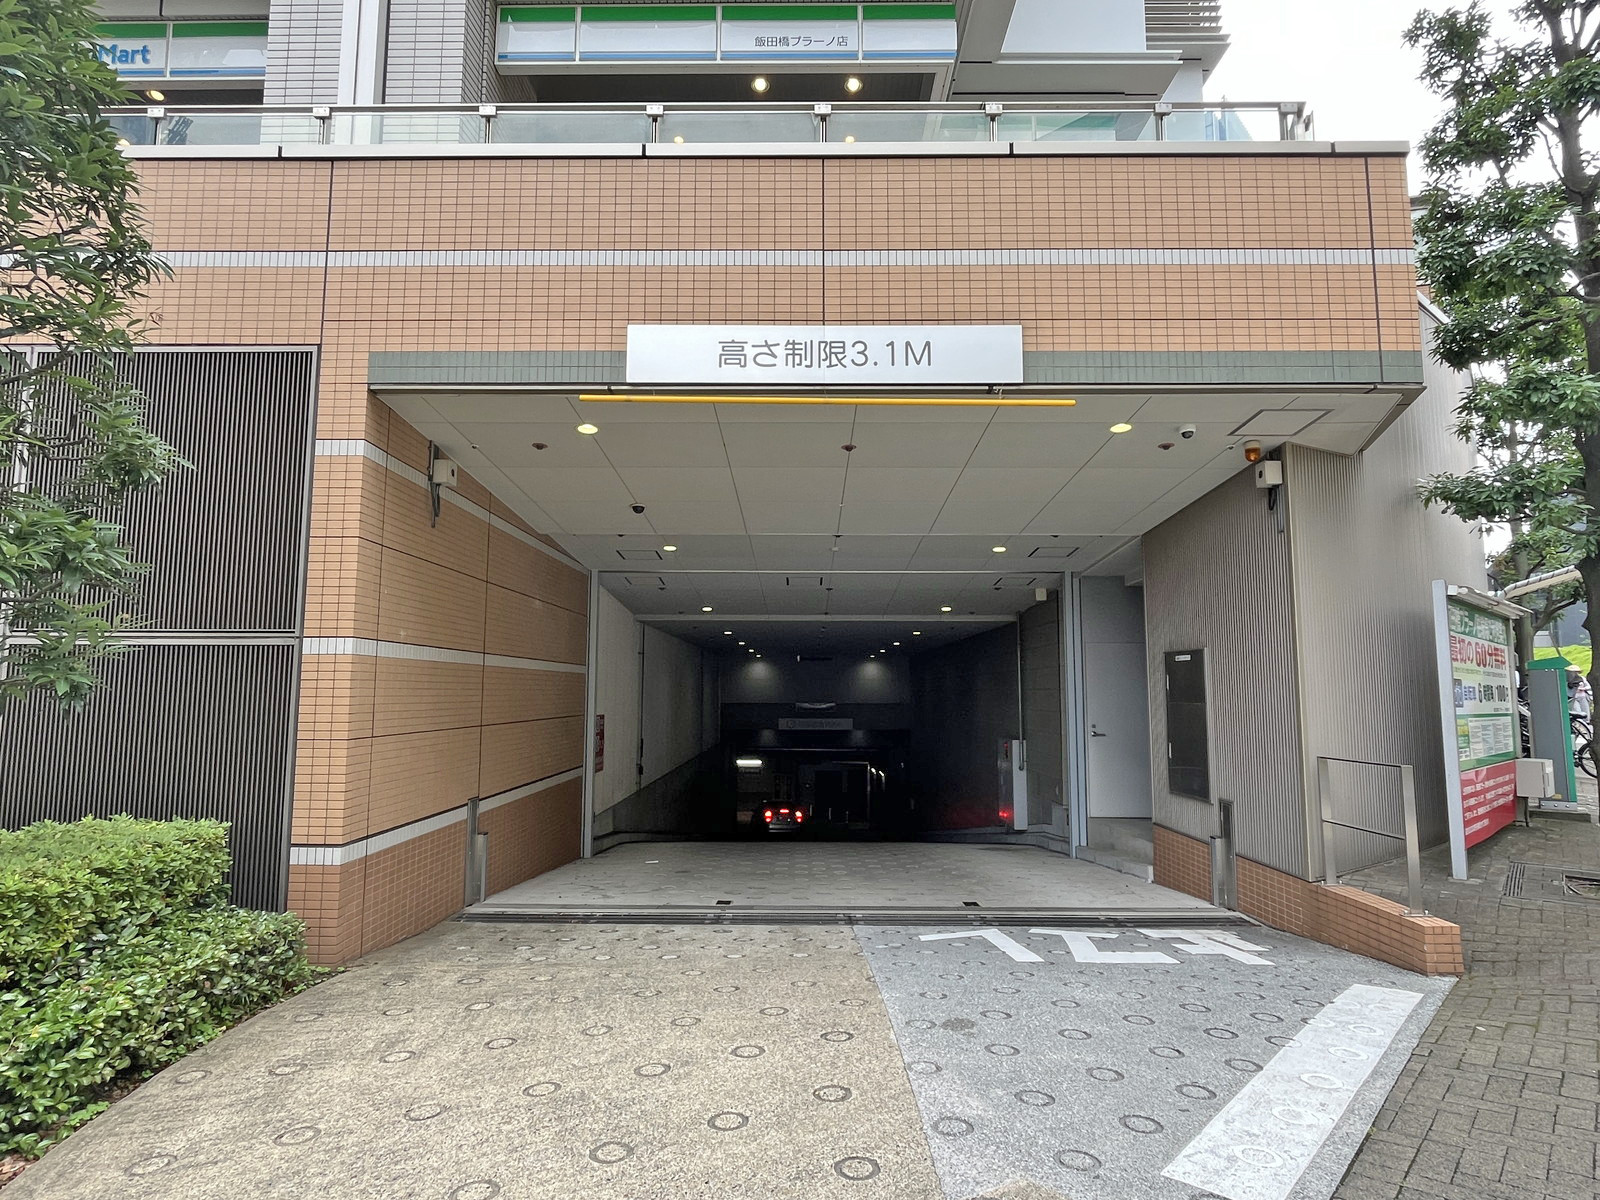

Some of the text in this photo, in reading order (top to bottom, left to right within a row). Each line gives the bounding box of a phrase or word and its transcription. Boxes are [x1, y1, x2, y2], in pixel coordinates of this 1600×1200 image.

[754, 36, 849, 47] 飯田橋プラーノ店
[718, 339, 933, 369] 高さ制限3.1M
